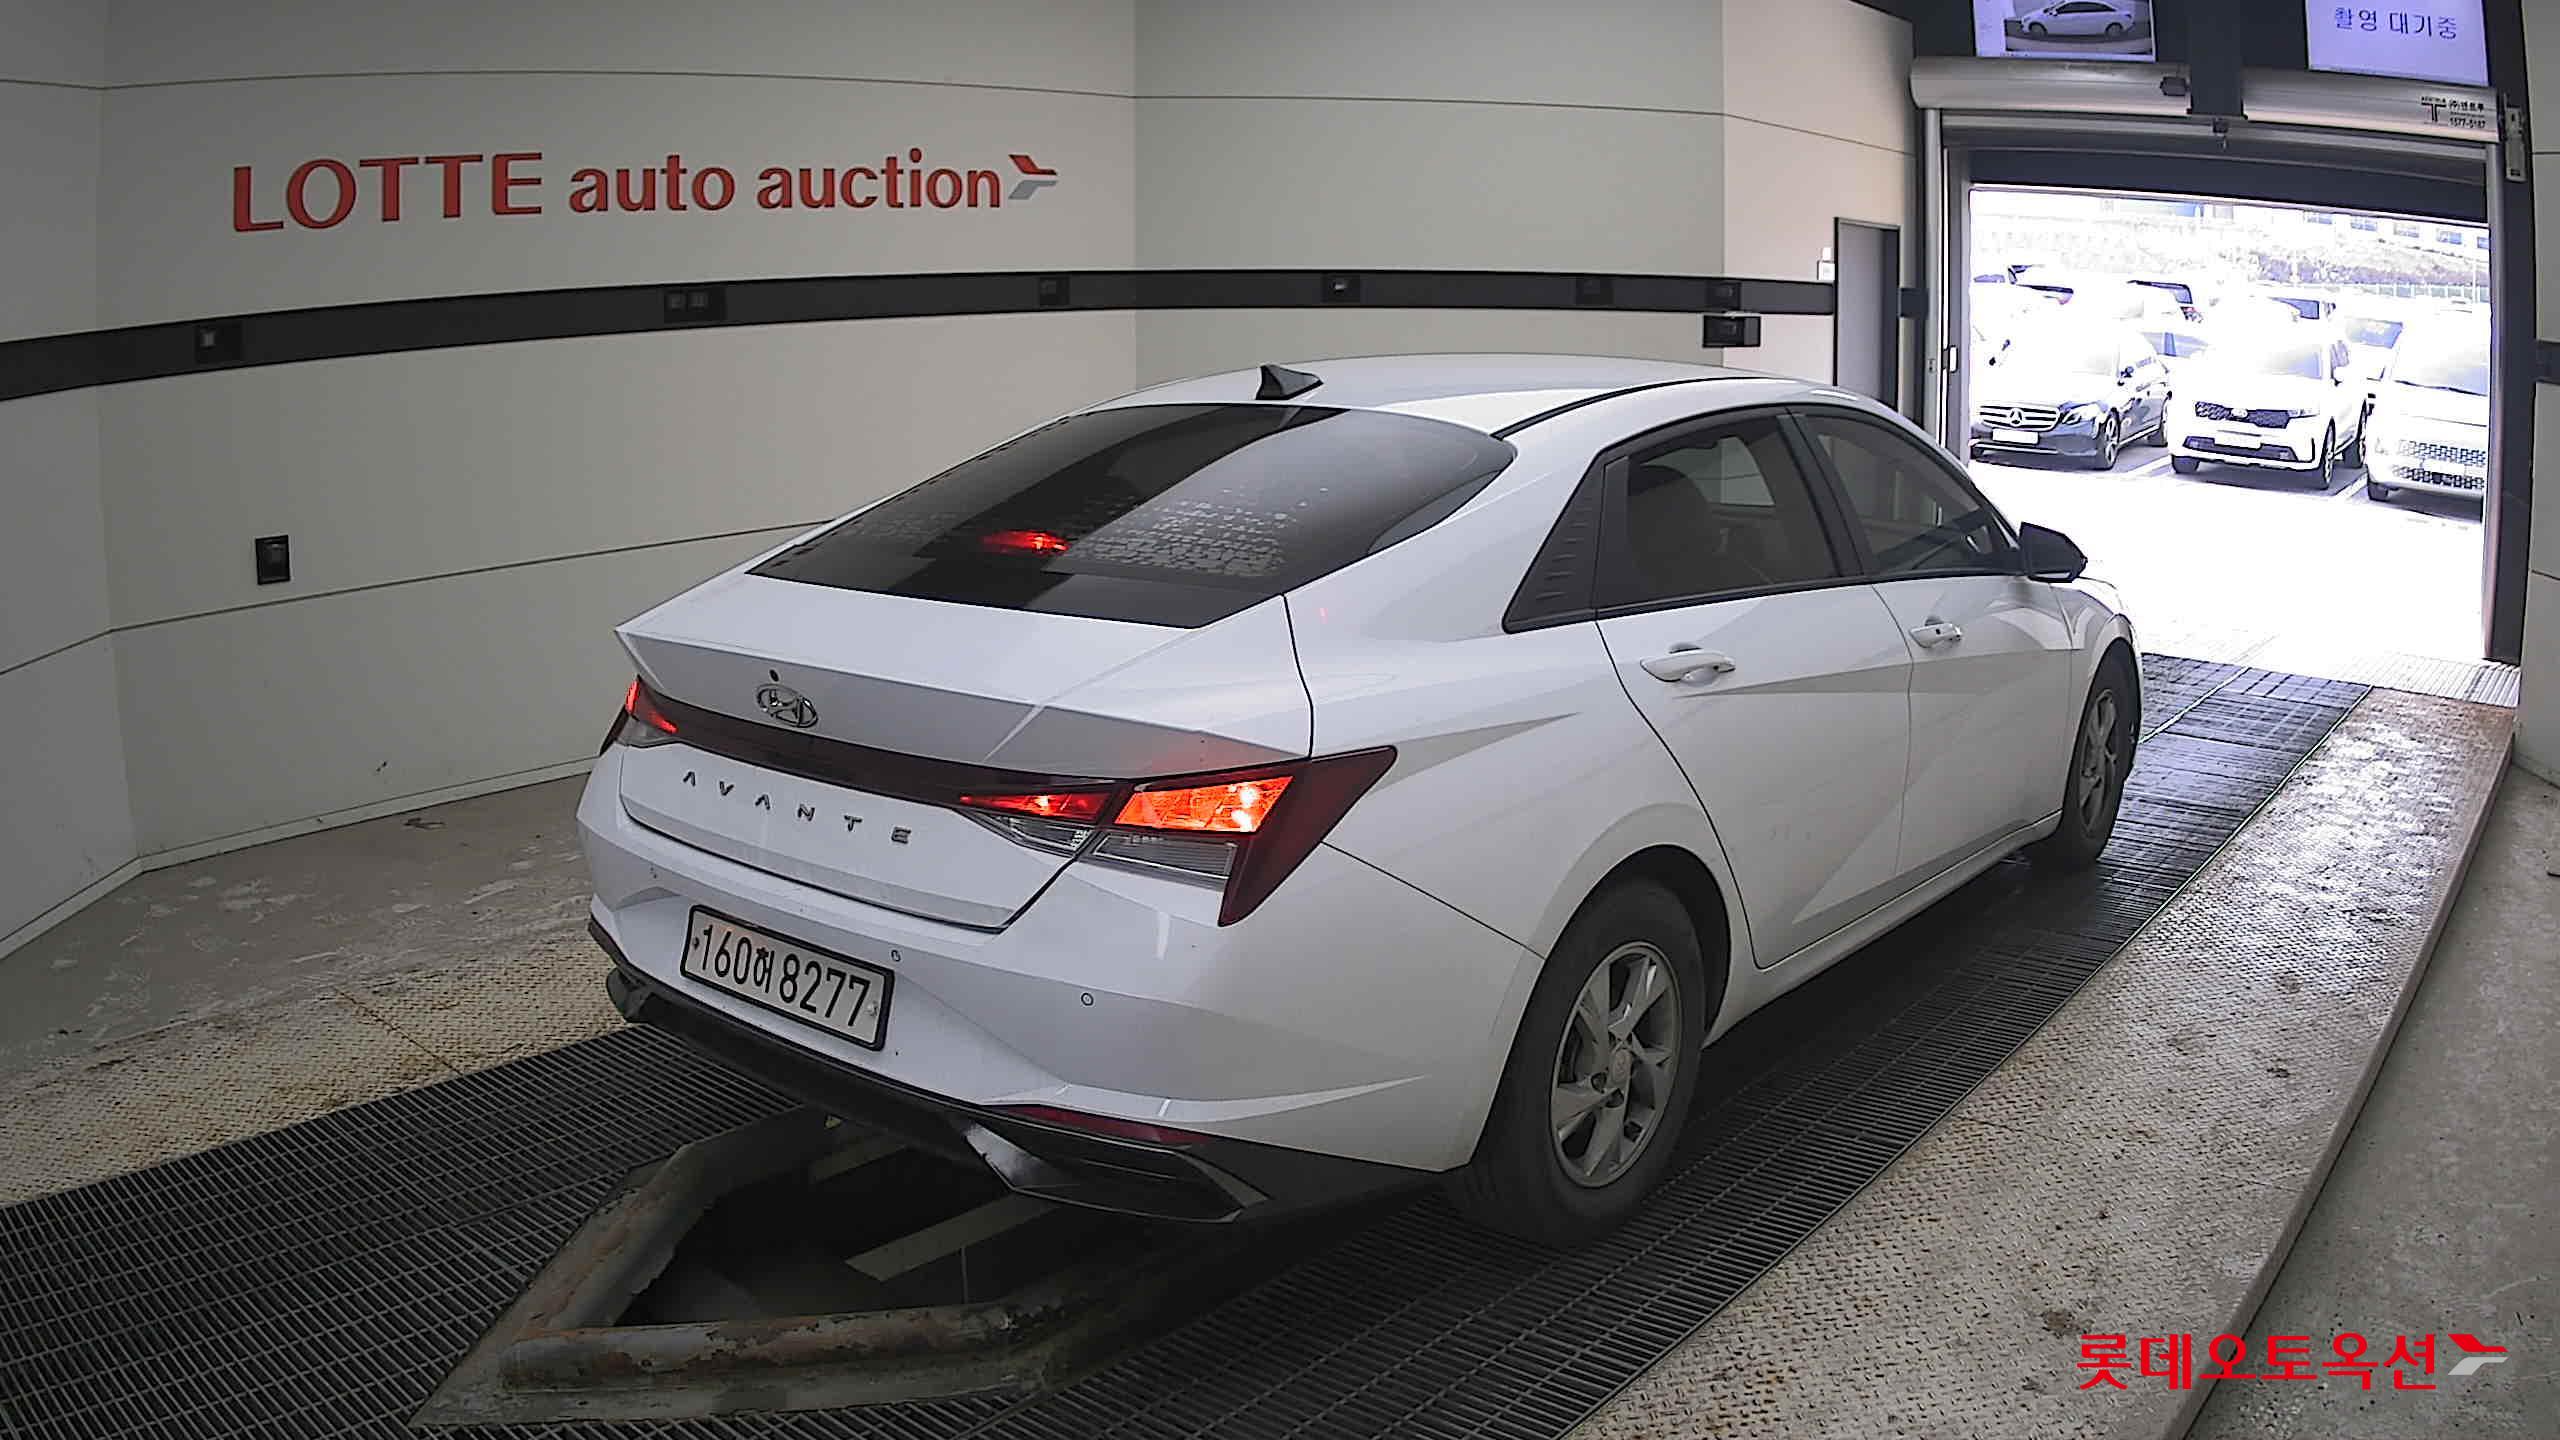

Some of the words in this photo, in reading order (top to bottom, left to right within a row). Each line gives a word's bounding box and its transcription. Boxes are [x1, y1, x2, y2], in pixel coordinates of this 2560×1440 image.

[2389, 11, 2457, 40] 대기중
[233, 152, 543, 233] LOTTE
[569, 154, 736, 214] auto
[757, 147, 1001, 209] auction
[683, 771, 912, 845] AVANTE
